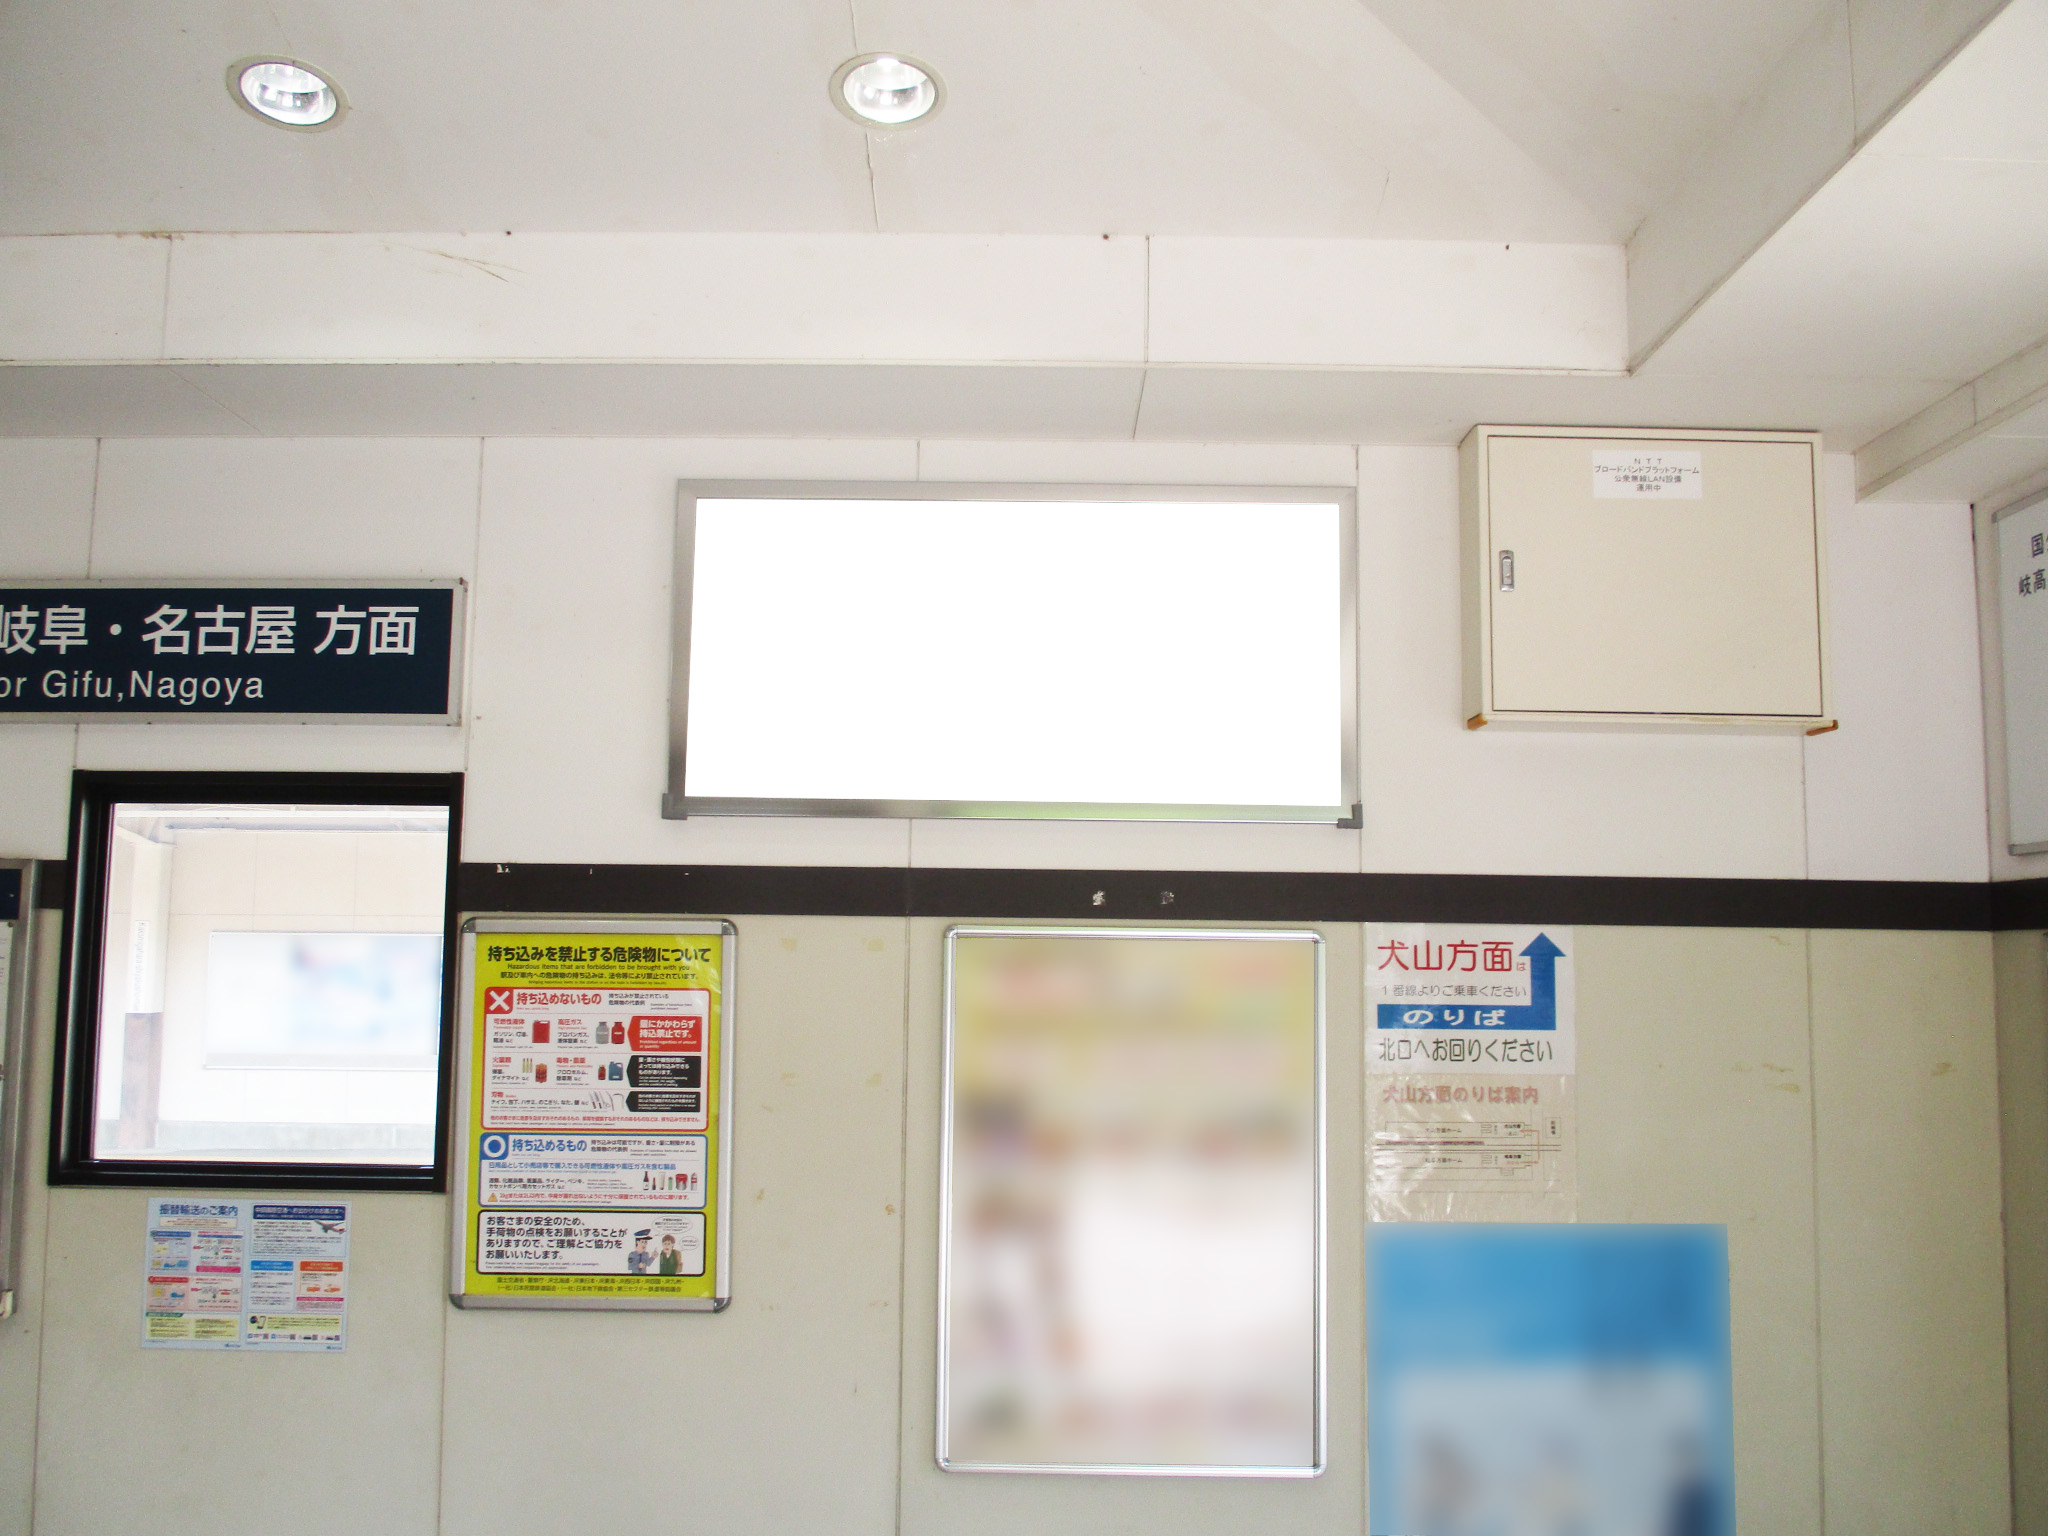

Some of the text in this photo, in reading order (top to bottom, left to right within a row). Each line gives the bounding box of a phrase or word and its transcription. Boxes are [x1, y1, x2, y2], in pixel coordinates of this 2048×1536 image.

[1595, 465, 1699, 474] ブロードバンドプラットフォーム
[1615, 475, 1682, 483] 公衆無線LAN設備
[1637, 484, 1661, 492] 運用中
[313, 604, 419, 656] 方面
[42, 670, 264, 706] Gifu,Nagoya
[488, 946, 711, 962] 持ち込みを禁止する危険物について
[1383, 985, 1527, 997] 1番線よりご乗車ください
[516, 993, 602, 1005] 持ち込めないもの
[1403, 1009, 1506, 1026] のりば
[1379, 1037, 1553, 1062] 北口へお回りください
[1383, 1085, 1539, 1104] 犬山方面のりば案内
[513, 1139, 588, 1151] 持ち込めるもの
[160, 1204, 238, 1216] 振替輸送のご案内
[487, 1217, 585, 1225] お客さまの安全のため、
[487, 1228, 627, 1237] 手荷物の点検をお願いすることが
[486, 1239, 623, 1249] ありますので、ご理解とご協力を
[486, 1250, 563, 1259] お願いいたします。
